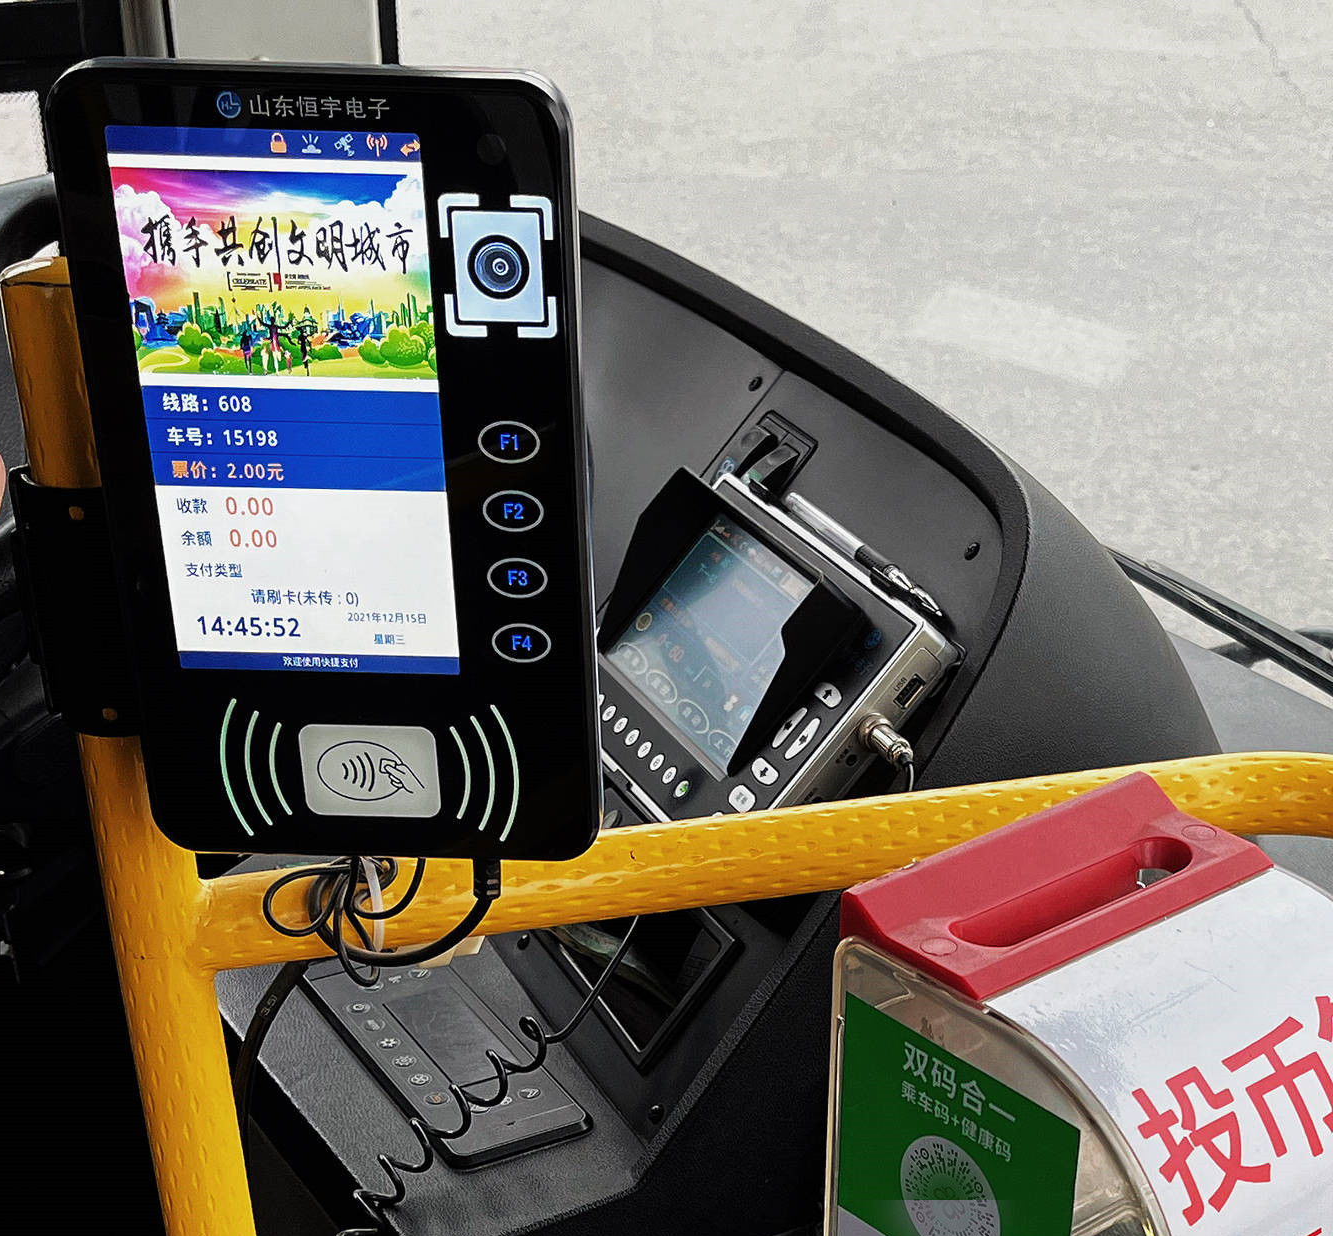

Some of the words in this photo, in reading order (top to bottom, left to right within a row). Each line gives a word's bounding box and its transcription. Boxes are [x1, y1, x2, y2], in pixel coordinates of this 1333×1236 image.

[249, 94, 390, 119] 山东恒宇电子
[141, 214, 414, 274] 携手共创文明城市
[499, 433, 519, 452] F1
[176, 496, 209, 515] 收款
[225, 496, 275, 517] 0.00
[503, 502, 524, 520] F2
[180, 529, 213, 548] 余额
[229, 528, 278, 549] 0.00
[184, 562, 243, 579] 支付类型
[507, 570, 528, 588] F3
[196, 615, 302, 639] 14:45:52
[347, 611, 428, 625] 2021年12月15日
[373, 633, 406, 646] 星期三
[511, 634, 532, 652] F4
[282, 655, 359, 670] 欢迎使用快捷支付
[902, 1039, 1017, 1124] 双码合一
[1131, 995, 1333, 1228] 投币
[900, 1080, 1013, 1164] 乘车码+健康码
